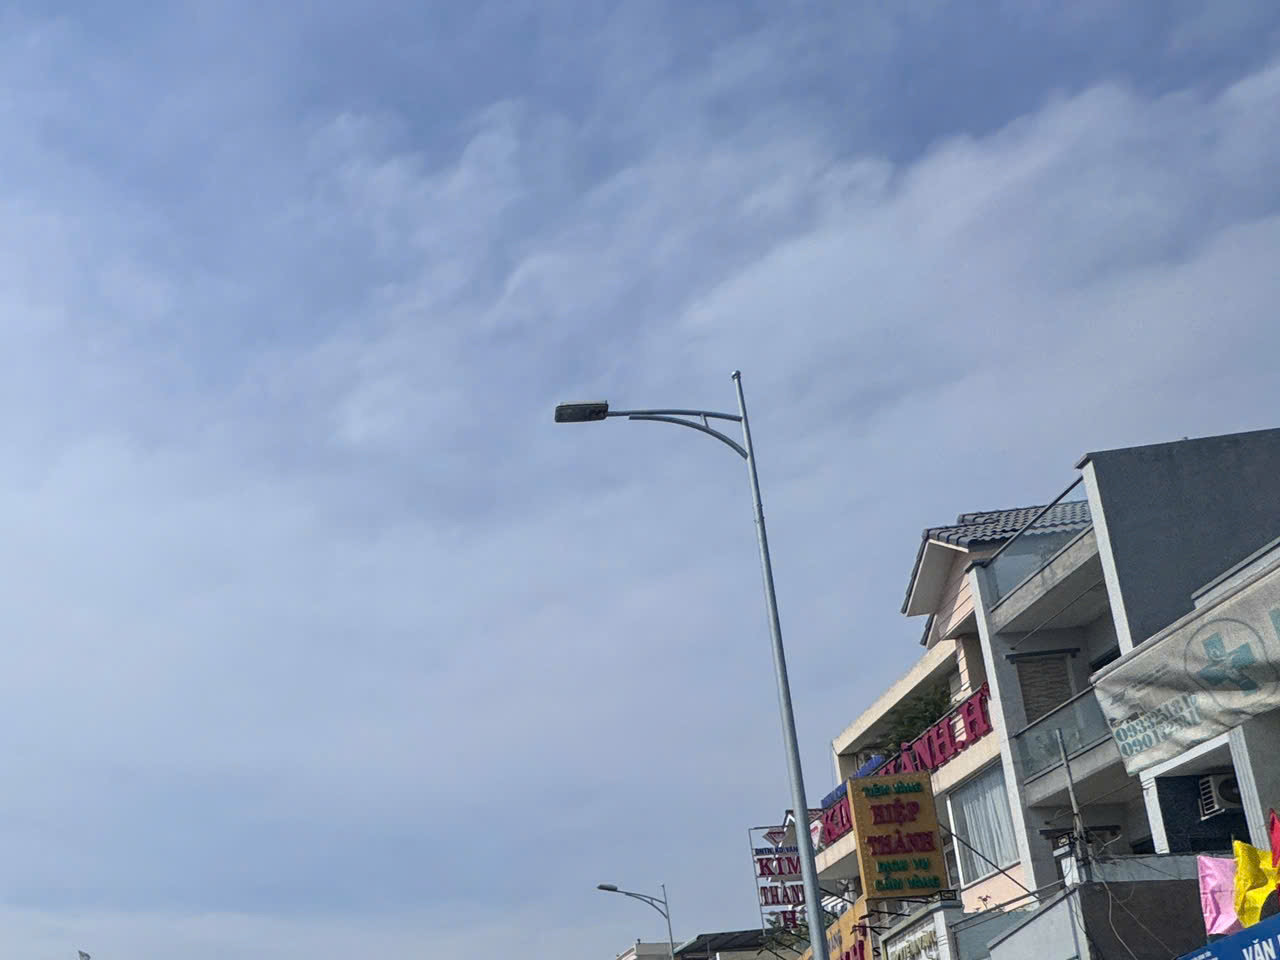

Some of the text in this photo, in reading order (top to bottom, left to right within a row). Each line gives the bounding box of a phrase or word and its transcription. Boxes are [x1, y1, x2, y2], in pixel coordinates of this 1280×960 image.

[870, 798, 920, 826] HIỆP
[865, 829, 936, 856] THÀNH
[756, 856, 802, 877] KIM
[760, 880, 807, 907] THÀN
